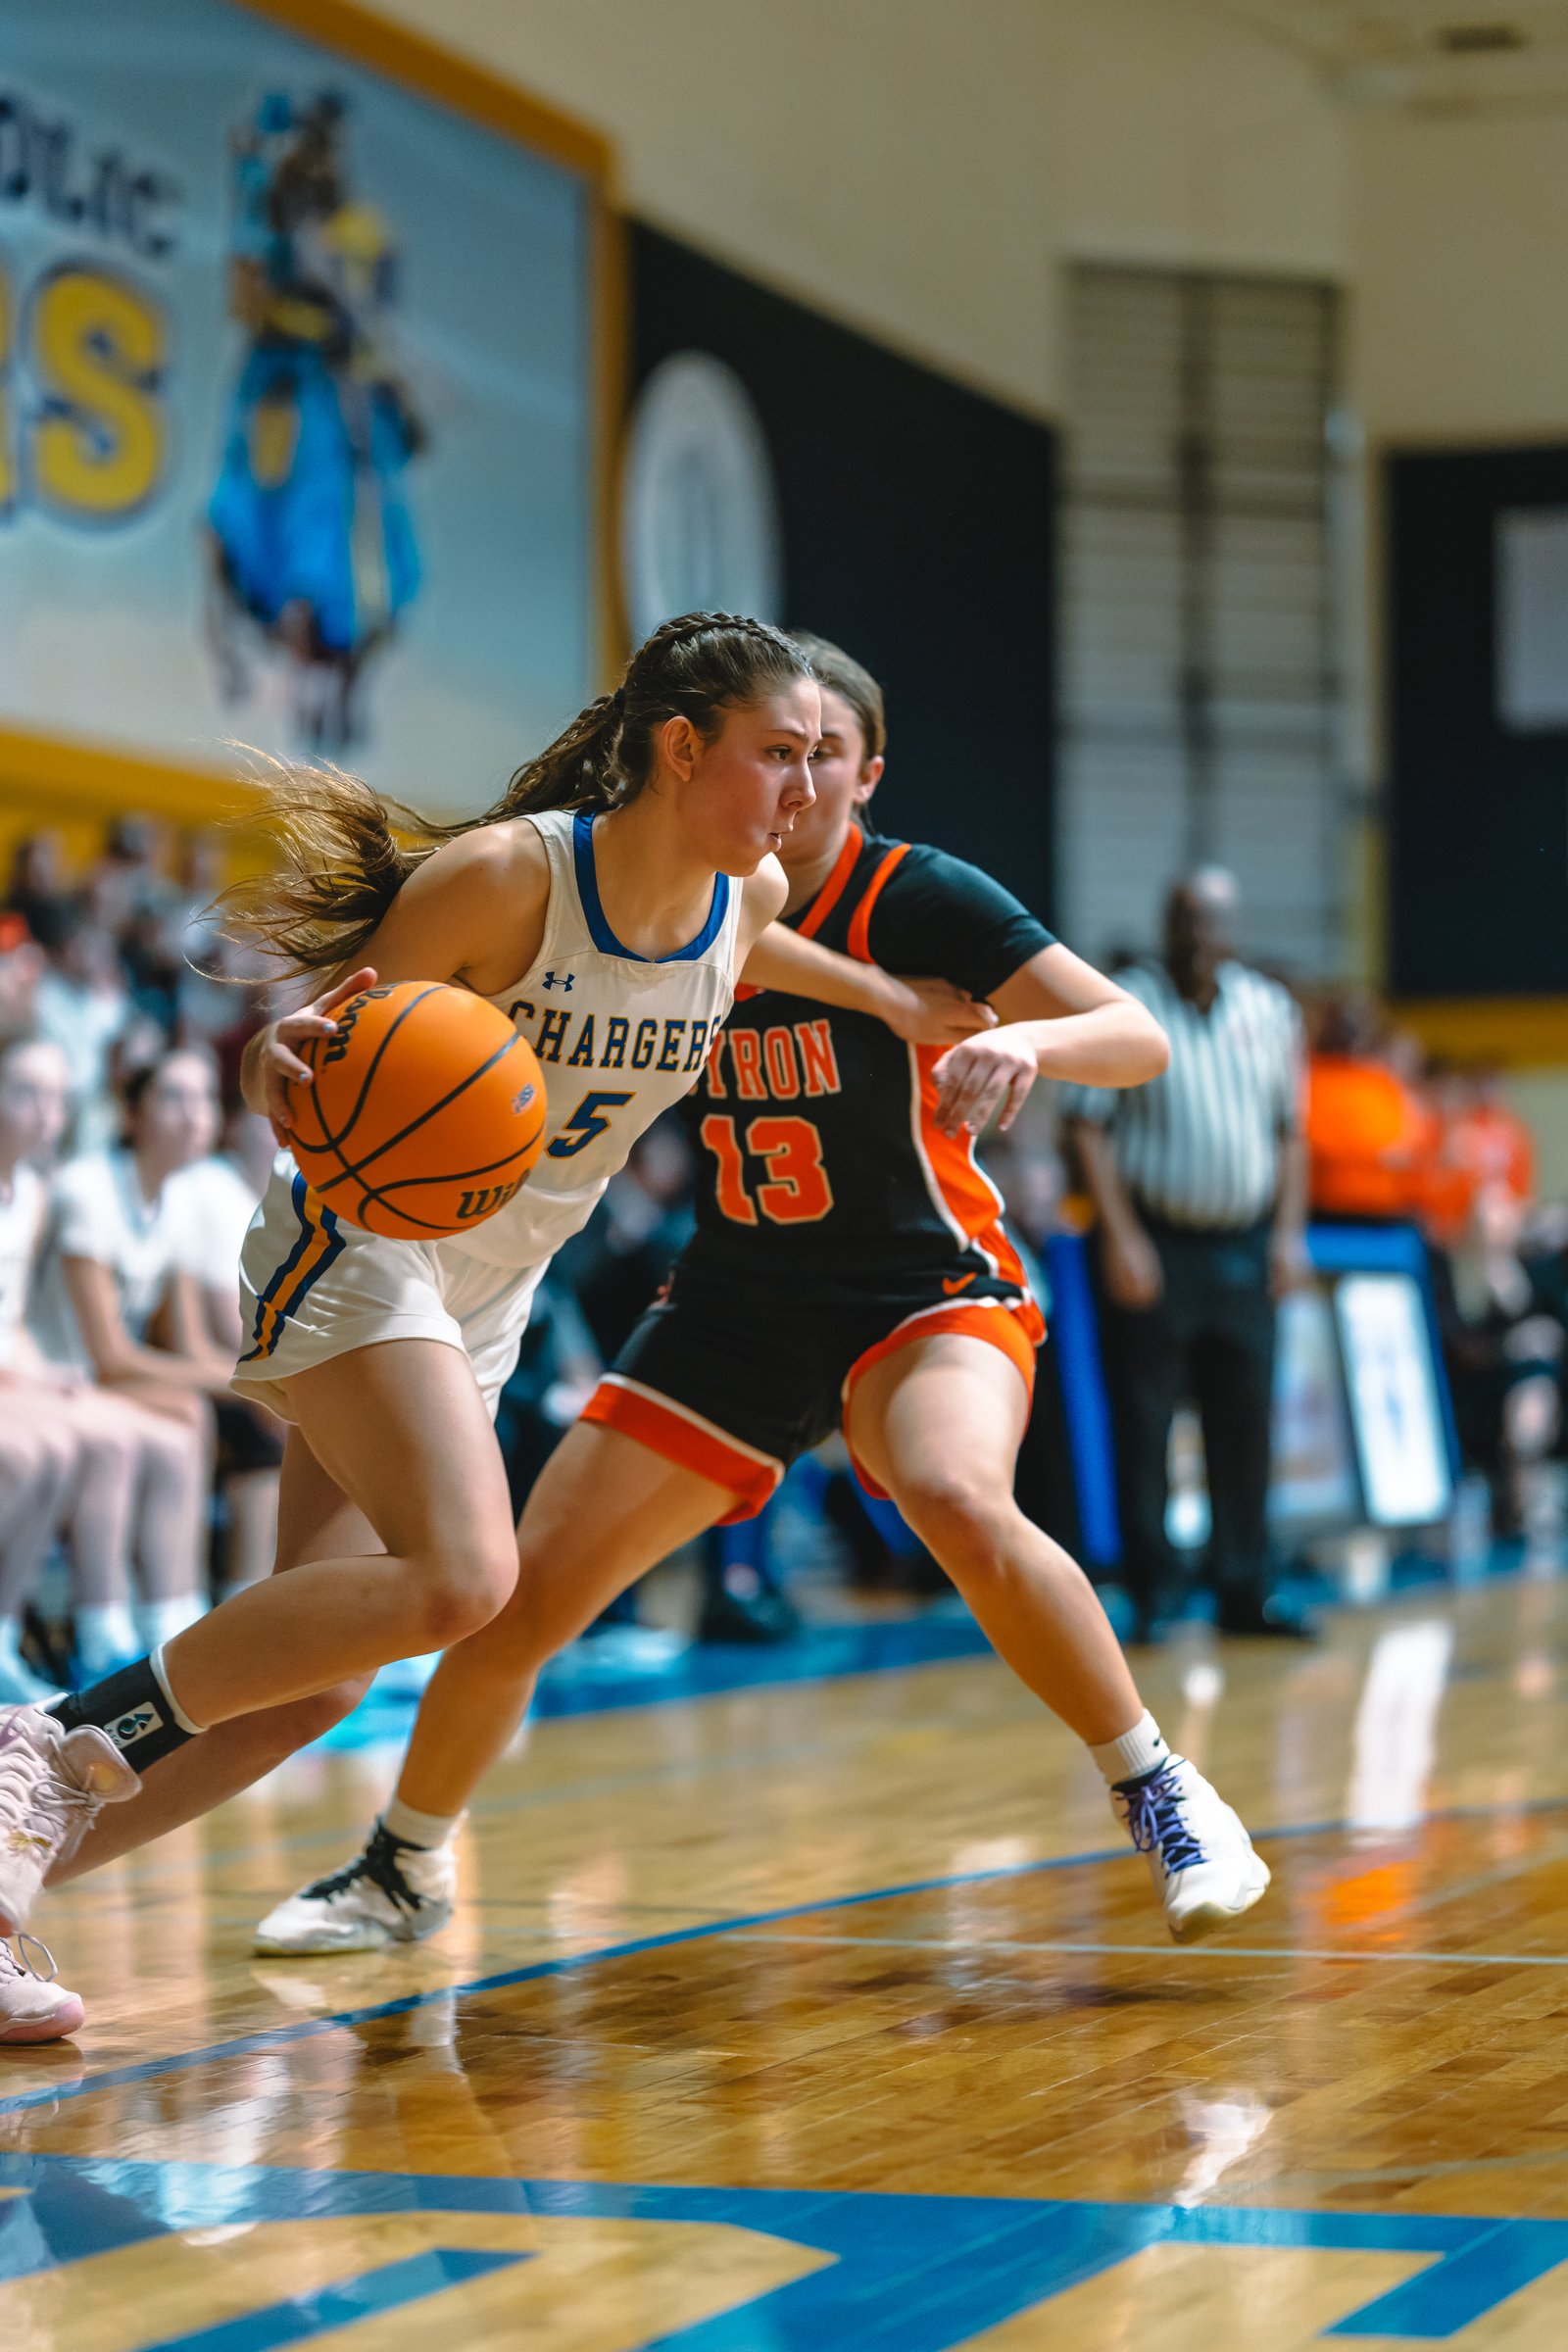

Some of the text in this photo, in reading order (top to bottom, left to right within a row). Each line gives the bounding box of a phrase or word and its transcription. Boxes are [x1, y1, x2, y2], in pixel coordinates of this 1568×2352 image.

[0, 259, 167, 525] S
[687, 1018, 842, 1101] YRON
[544, 1090, 637, 1159] 5
[700, 1113, 834, 1226] 13
